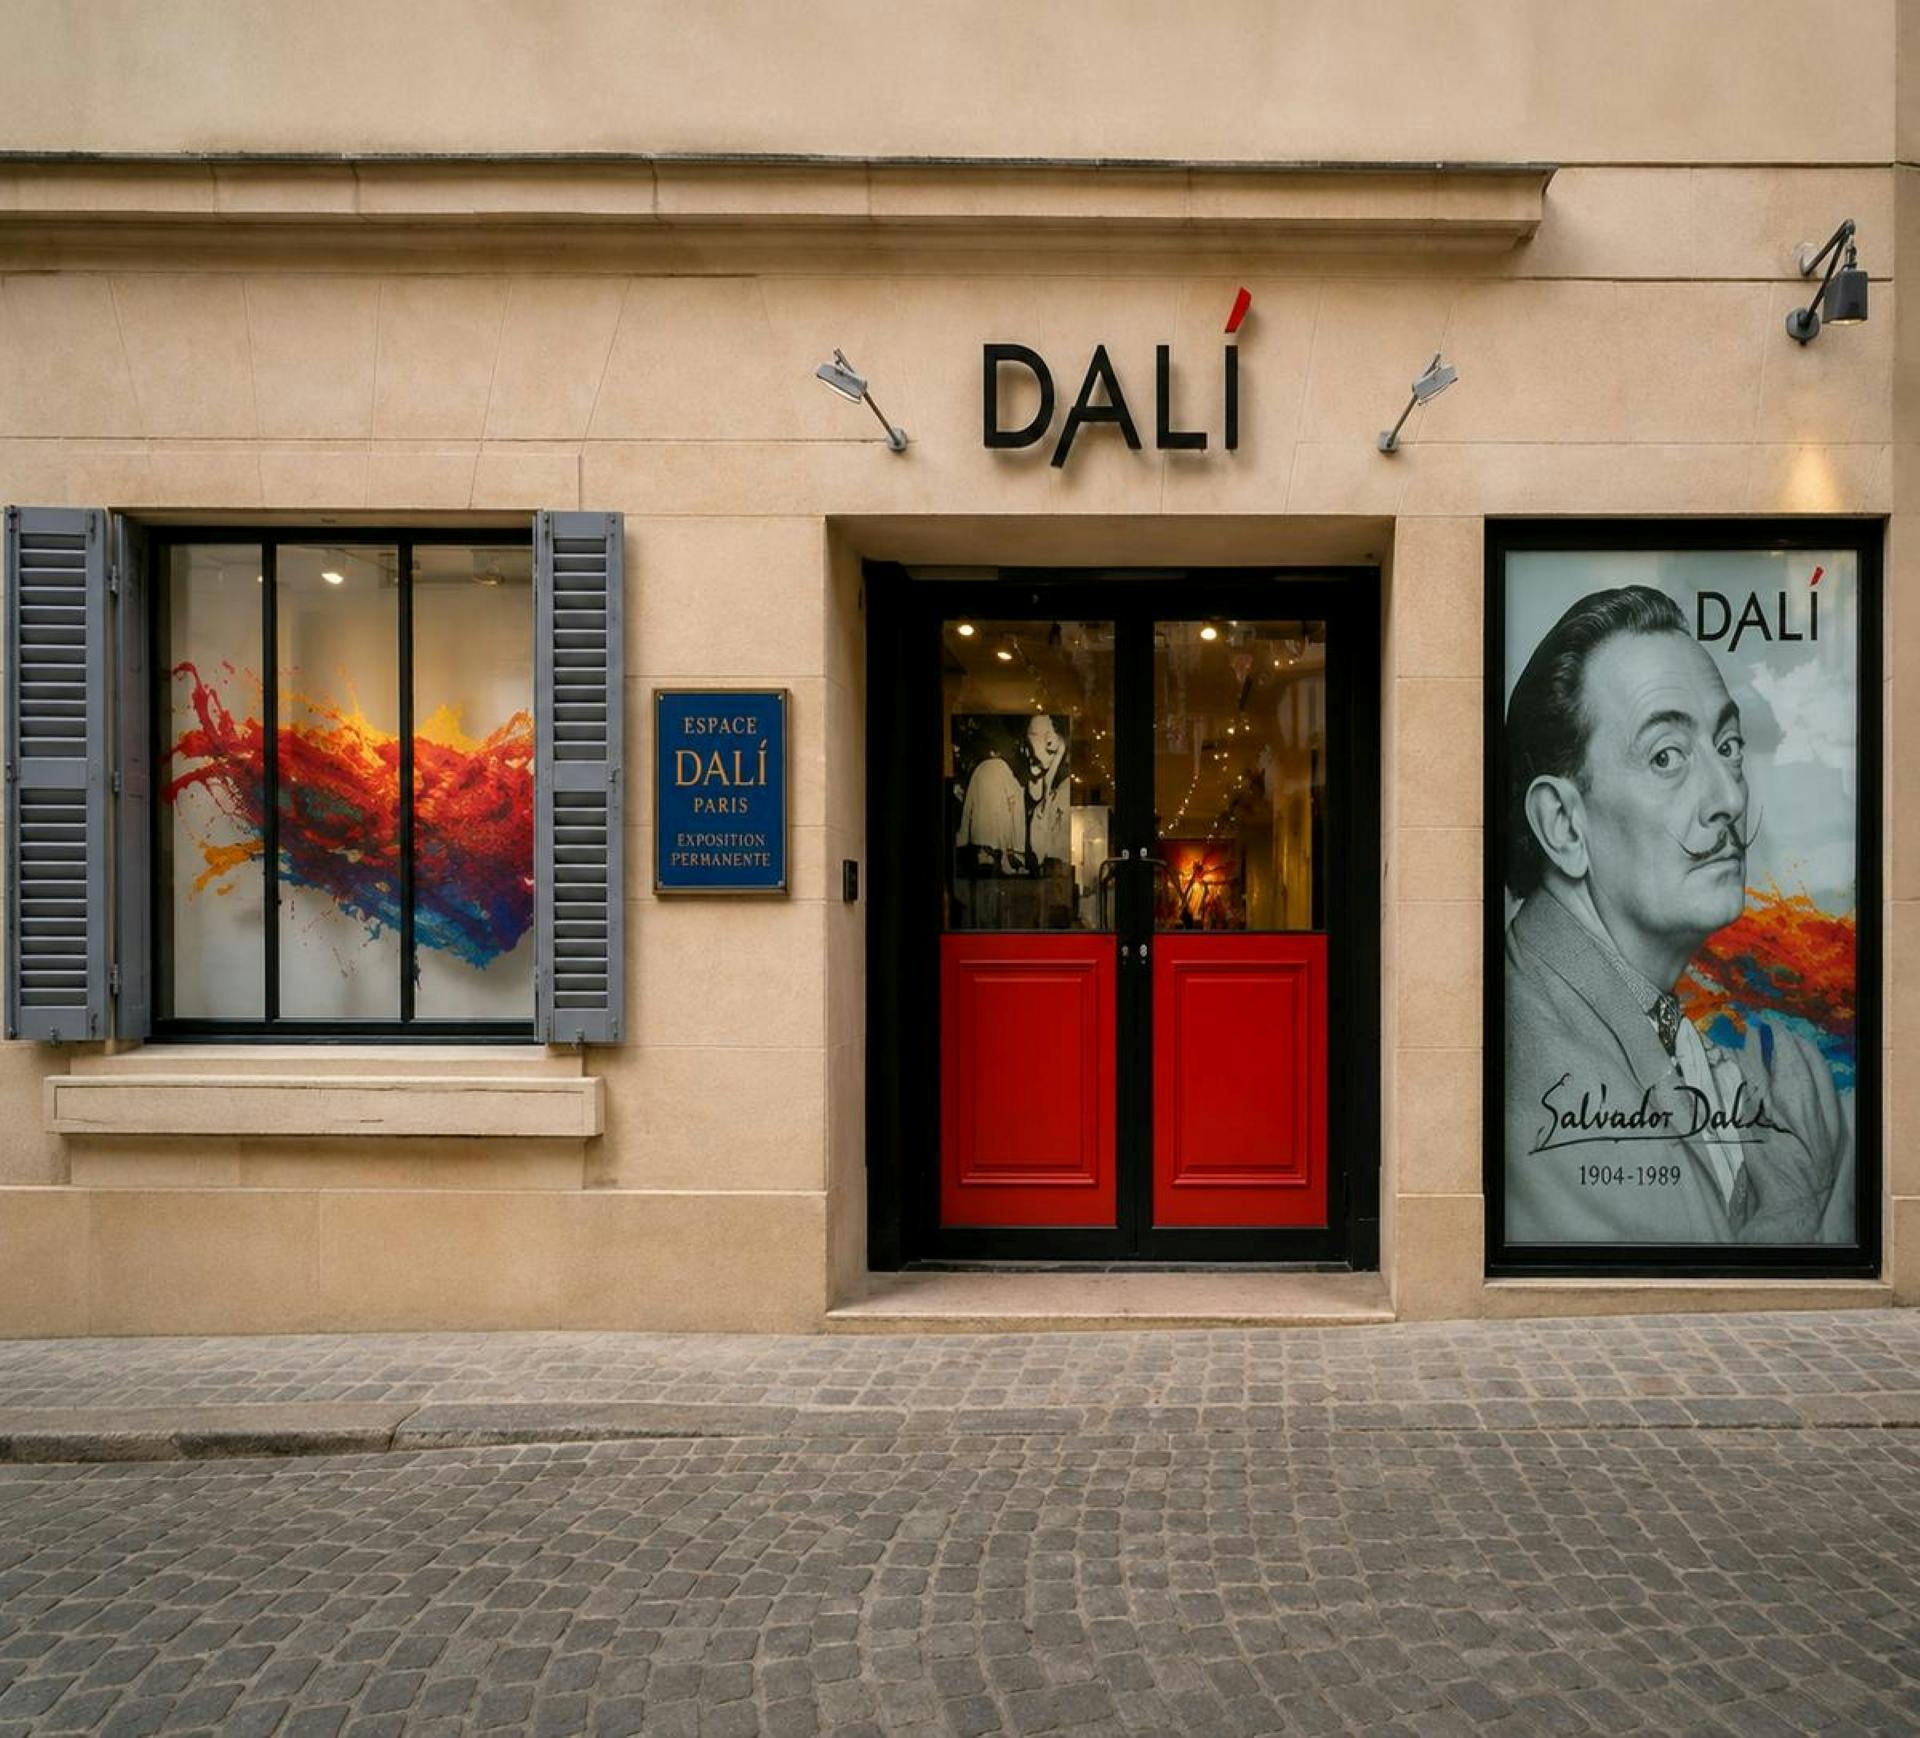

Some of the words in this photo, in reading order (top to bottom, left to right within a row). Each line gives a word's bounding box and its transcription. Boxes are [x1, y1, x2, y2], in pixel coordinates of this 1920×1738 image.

[984, 287, 1251, 468] DALÍ
[1697, 566, 1824, 652] DALÍ
[684, 716, 758, 735] ESPACE
[675, 739, 768, 786] DALÍ
[693, 797, 749, 814] PARIS
[677, 832, 766, 847] EXPOSITION
[671, 852, 771, 867] PERMANENTE
[1529, 1073, 1673, 1155] Salvador
[1579, 1165, 1681, 1186] 1904-1989
